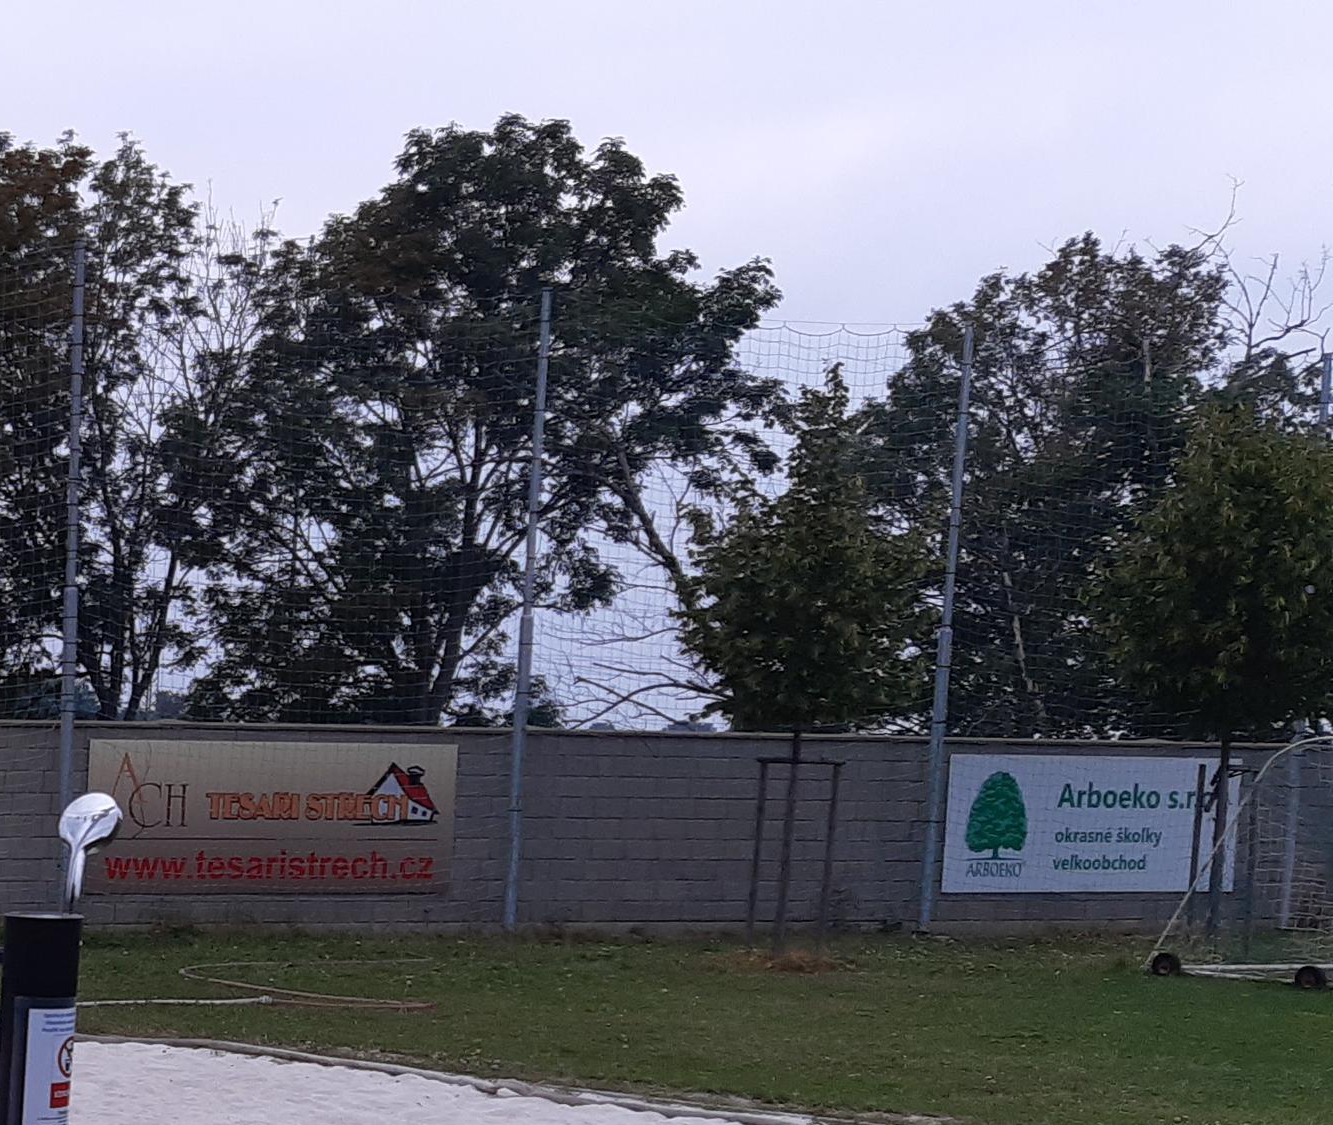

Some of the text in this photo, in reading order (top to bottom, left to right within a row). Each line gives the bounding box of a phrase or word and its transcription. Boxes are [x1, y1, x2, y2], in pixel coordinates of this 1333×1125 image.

[1056, 782, 1162, 810] Arboeko
[1054, 827, 1113, 844] okrasné
[104, 849, 434, 880] www.tesaristrech.cz
[965, 861, 1022, 878] ARBOEKO
